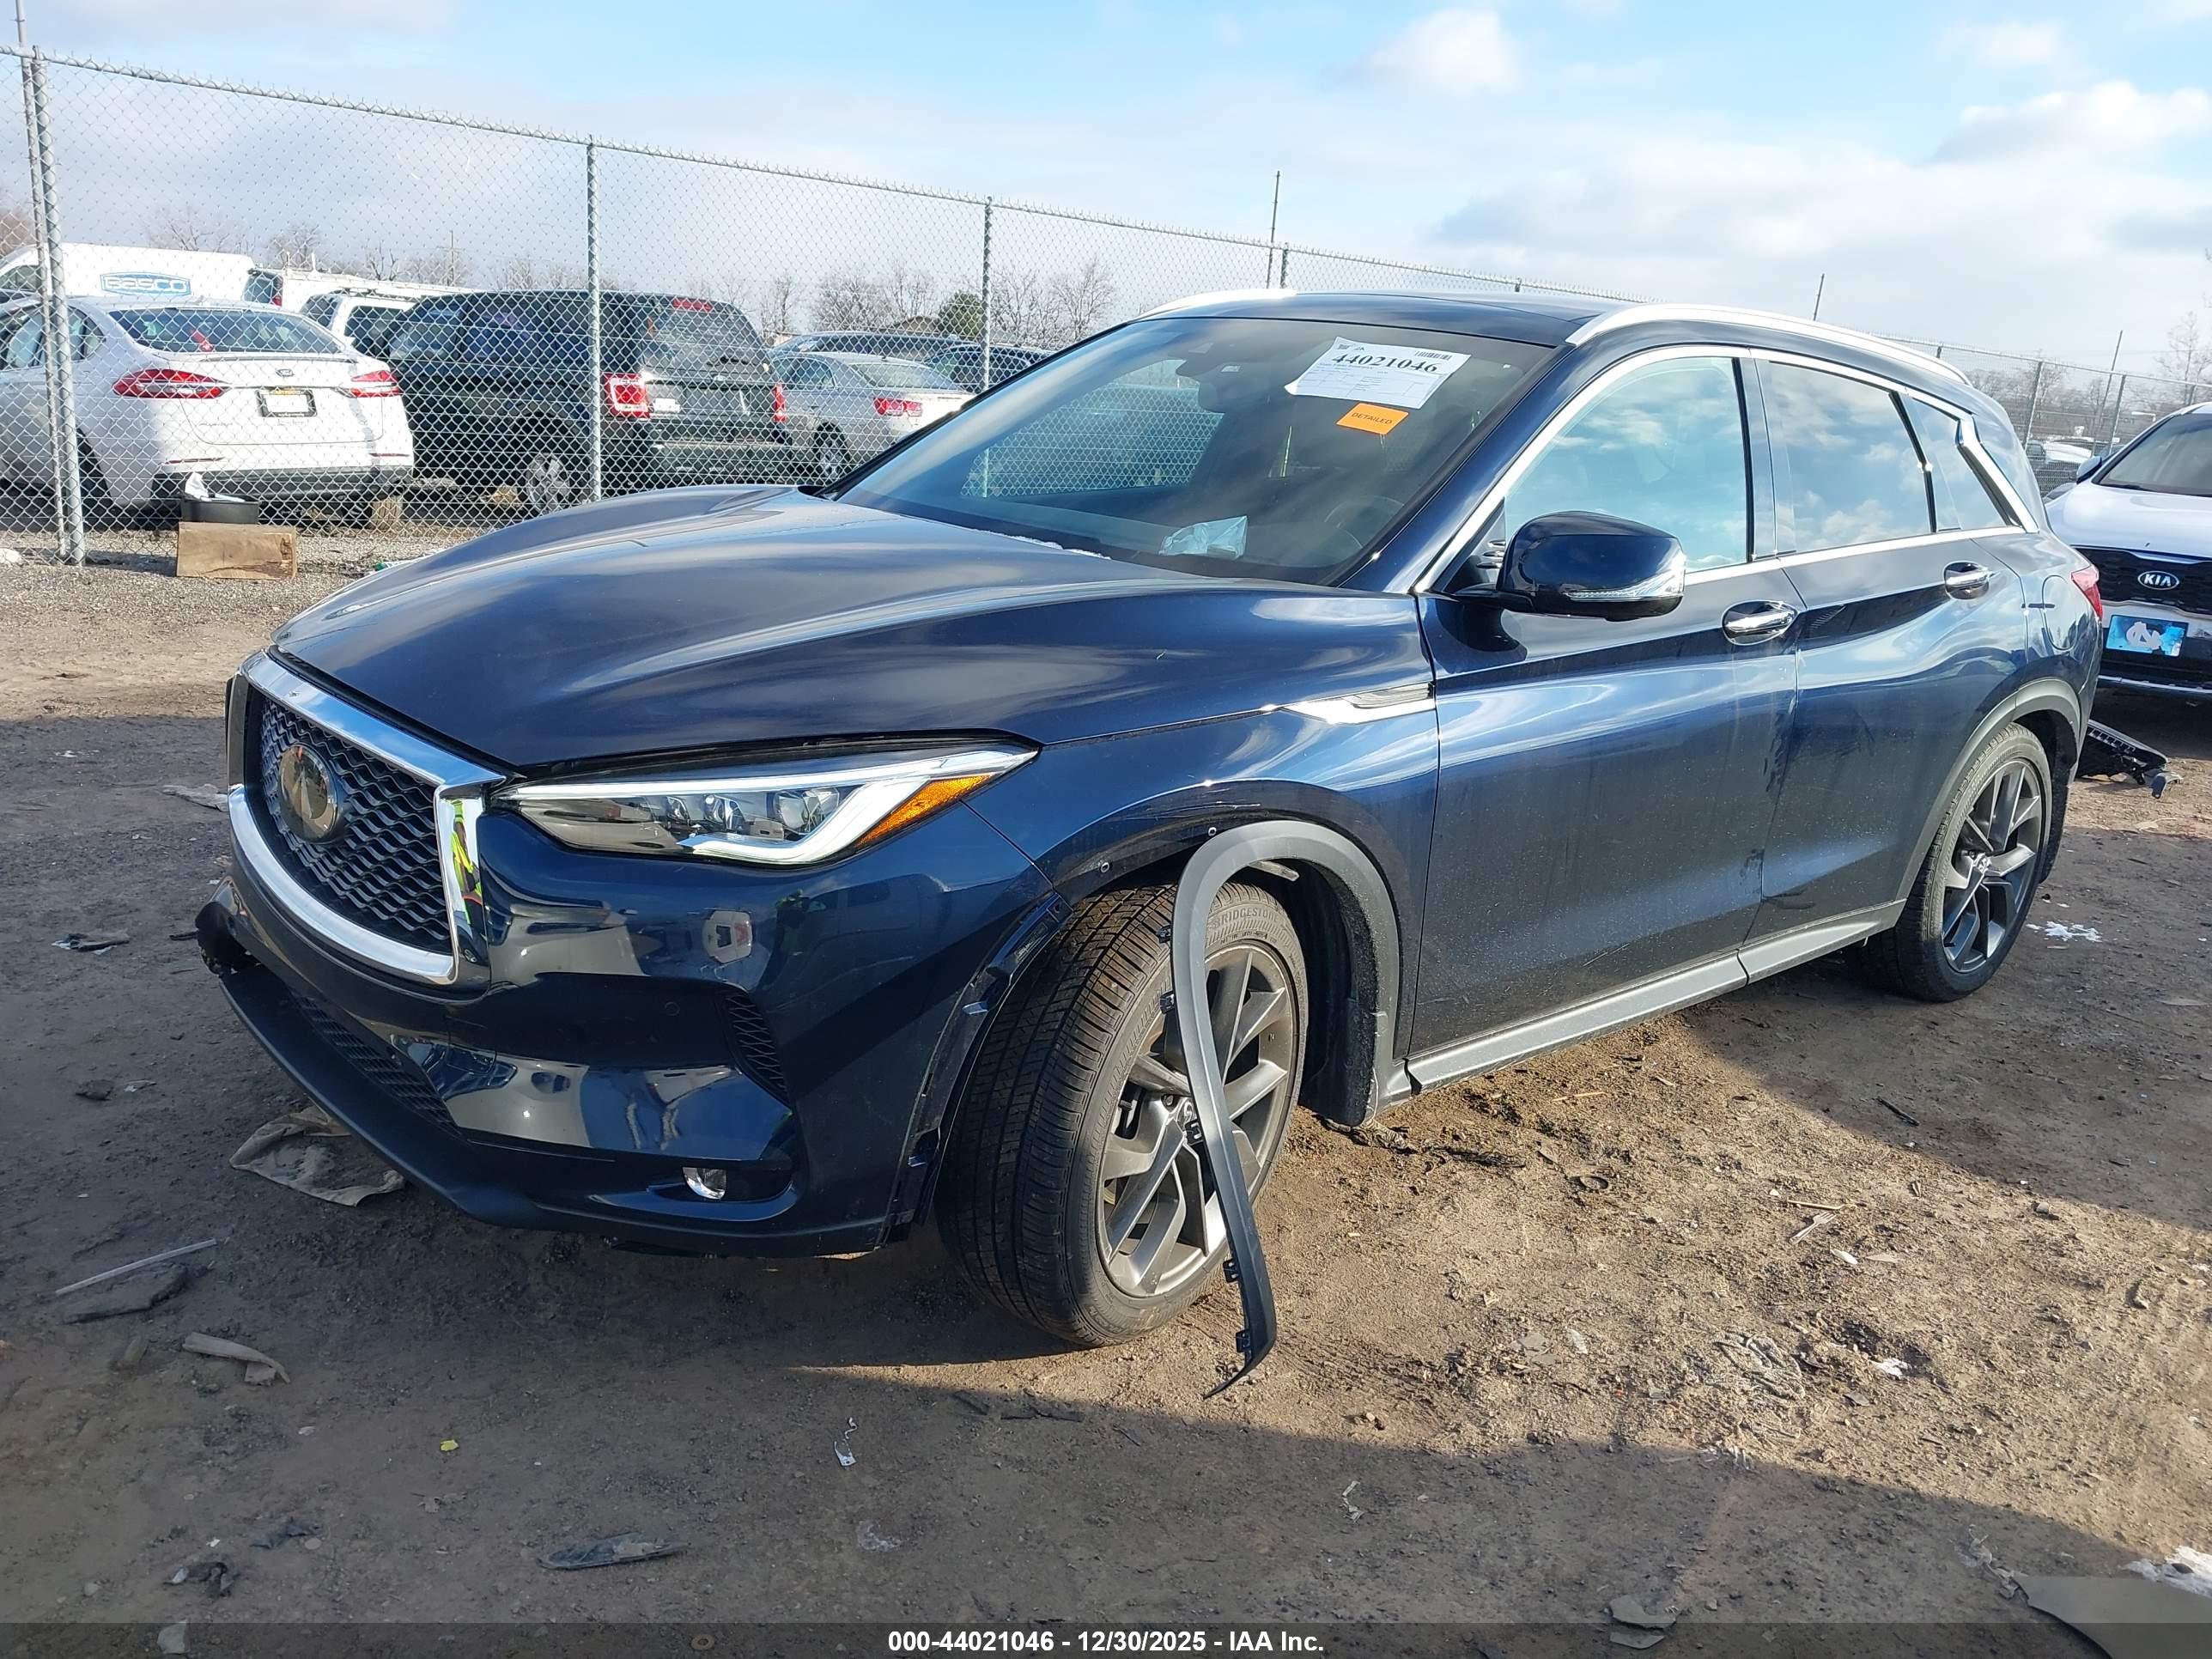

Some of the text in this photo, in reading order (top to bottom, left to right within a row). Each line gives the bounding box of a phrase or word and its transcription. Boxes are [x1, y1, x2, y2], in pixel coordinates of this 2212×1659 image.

[1333, 353, 1442, 373] 44021046
[1351, 412, 1393, 425] DETAILED
[2144, 574, 2172, 587] KIA
